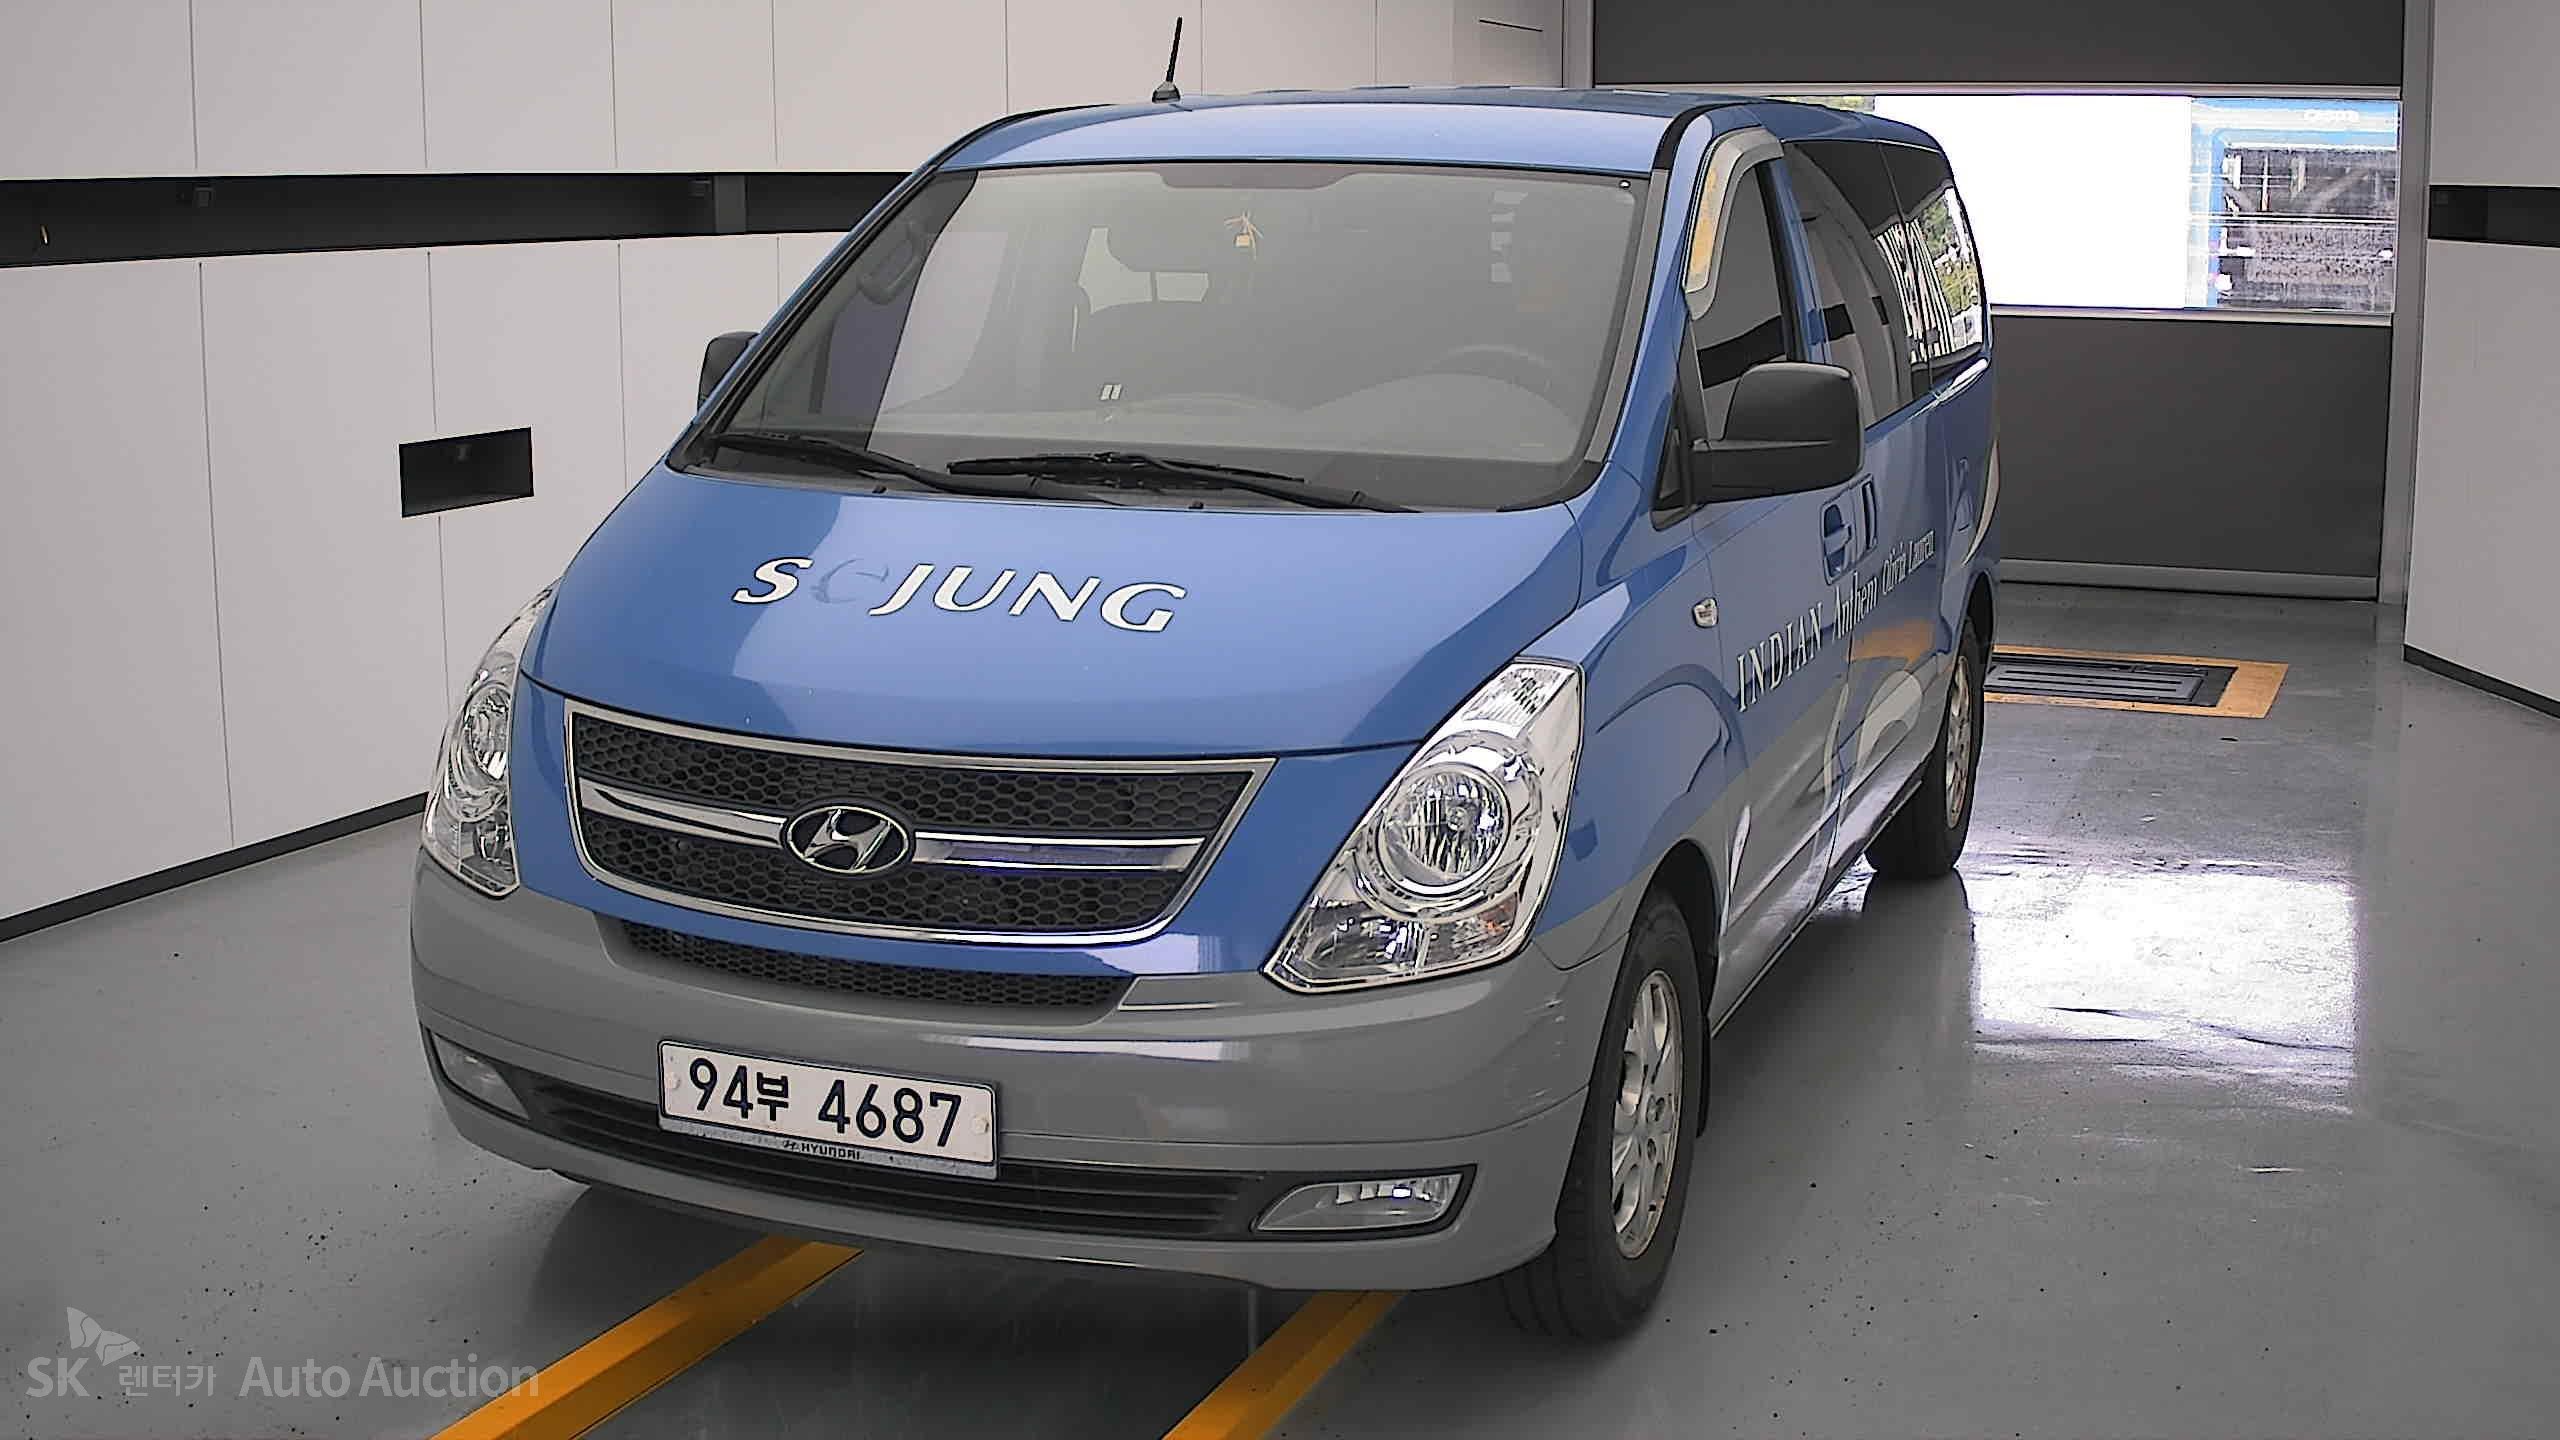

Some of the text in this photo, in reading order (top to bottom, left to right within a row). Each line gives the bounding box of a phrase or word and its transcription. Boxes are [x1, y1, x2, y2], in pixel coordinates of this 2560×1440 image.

[1737, 602, 1823, 713] INDIAN
[1833, 571, 1879, 643] Anthem
[689, 1057, 962, 1148] 94부 4687
[801, 1142, 861, 1161] HYUNDAI
